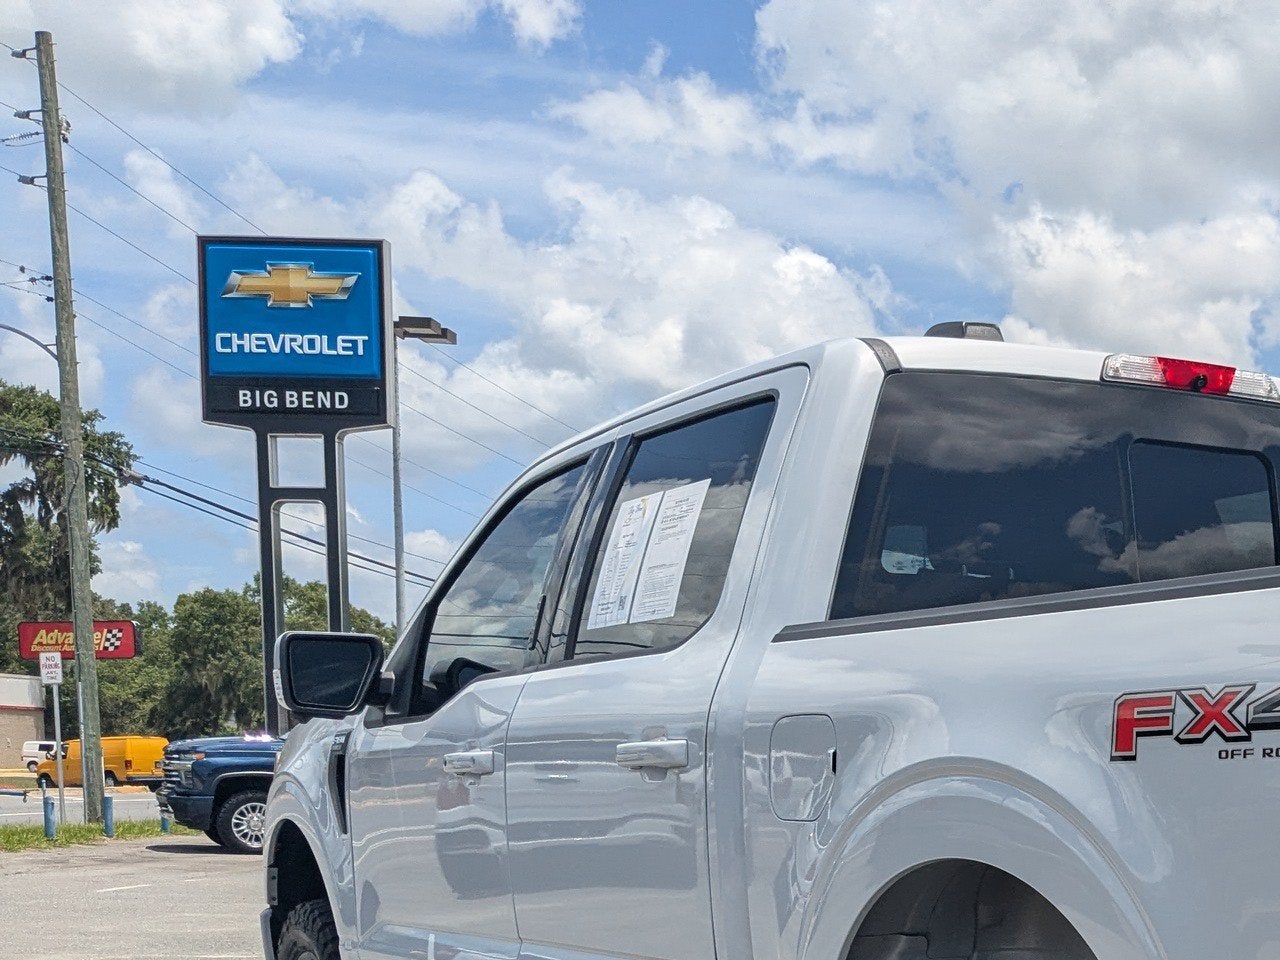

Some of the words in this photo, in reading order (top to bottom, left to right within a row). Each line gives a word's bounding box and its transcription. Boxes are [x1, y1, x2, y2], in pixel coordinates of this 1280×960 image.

[215, 333, 369, 356] CHEVROLET
[238, 390, 278, 408] BIG
[285, 390, 349, 409] BEND
[33, 629, 102, 646] Advae
[45, 655, 56, 663] NO
[1218, 748, 1254, 760] OFF
